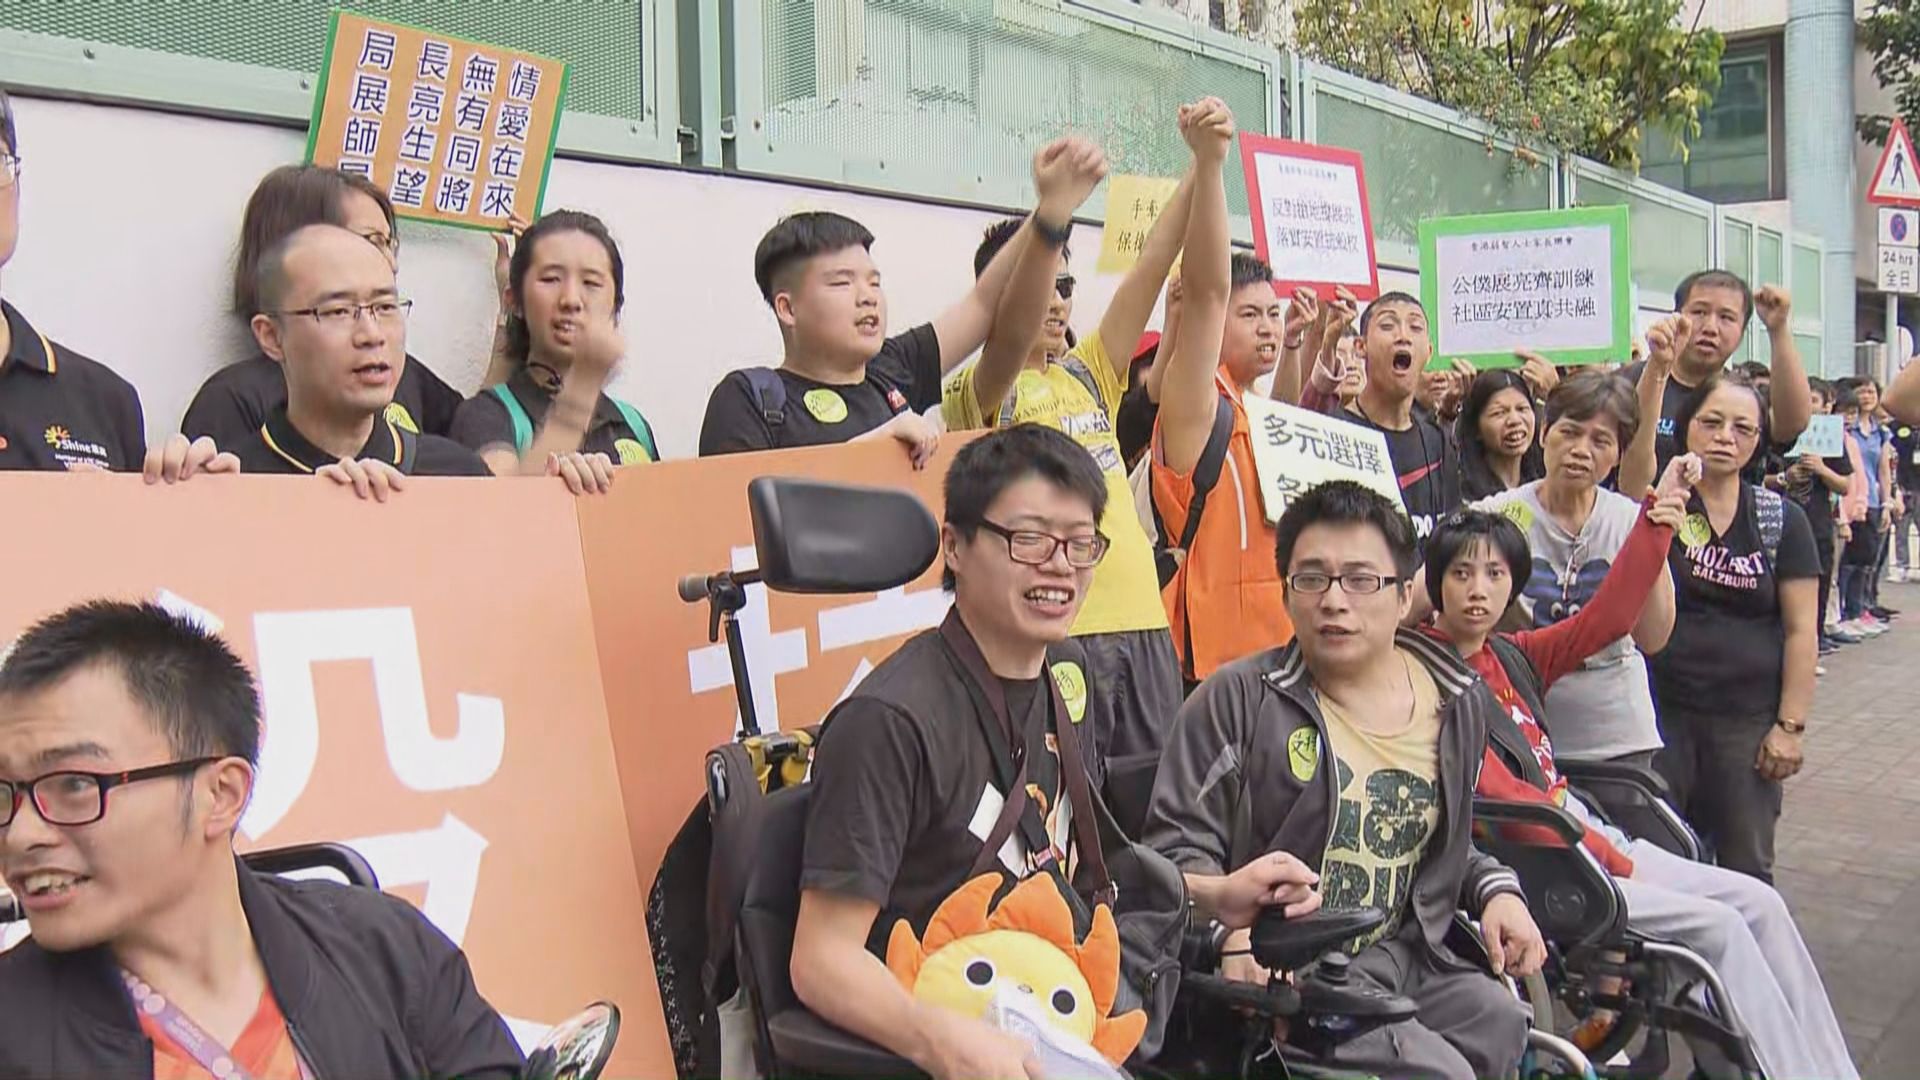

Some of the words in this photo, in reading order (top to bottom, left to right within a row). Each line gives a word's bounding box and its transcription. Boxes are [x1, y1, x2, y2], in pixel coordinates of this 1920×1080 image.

[359, 31, 541, 101] 局長無情
[352, 75, 529, 141] 展亮有愛
[344, 117, 522, 179] 師生同在
[1883, 251, 1896, 264] 24
[1899, 253, 1914, 266] hrs
[1886, 269, 1910, 287] 全日
[1452, 297, 1596, 325] 社區安置真共融
[1263, 413, 1385, 476] 多元選擇
[1684, 544, 1765, 576] MOZART
[1692, 564, 1758, 590] SALZBURG
